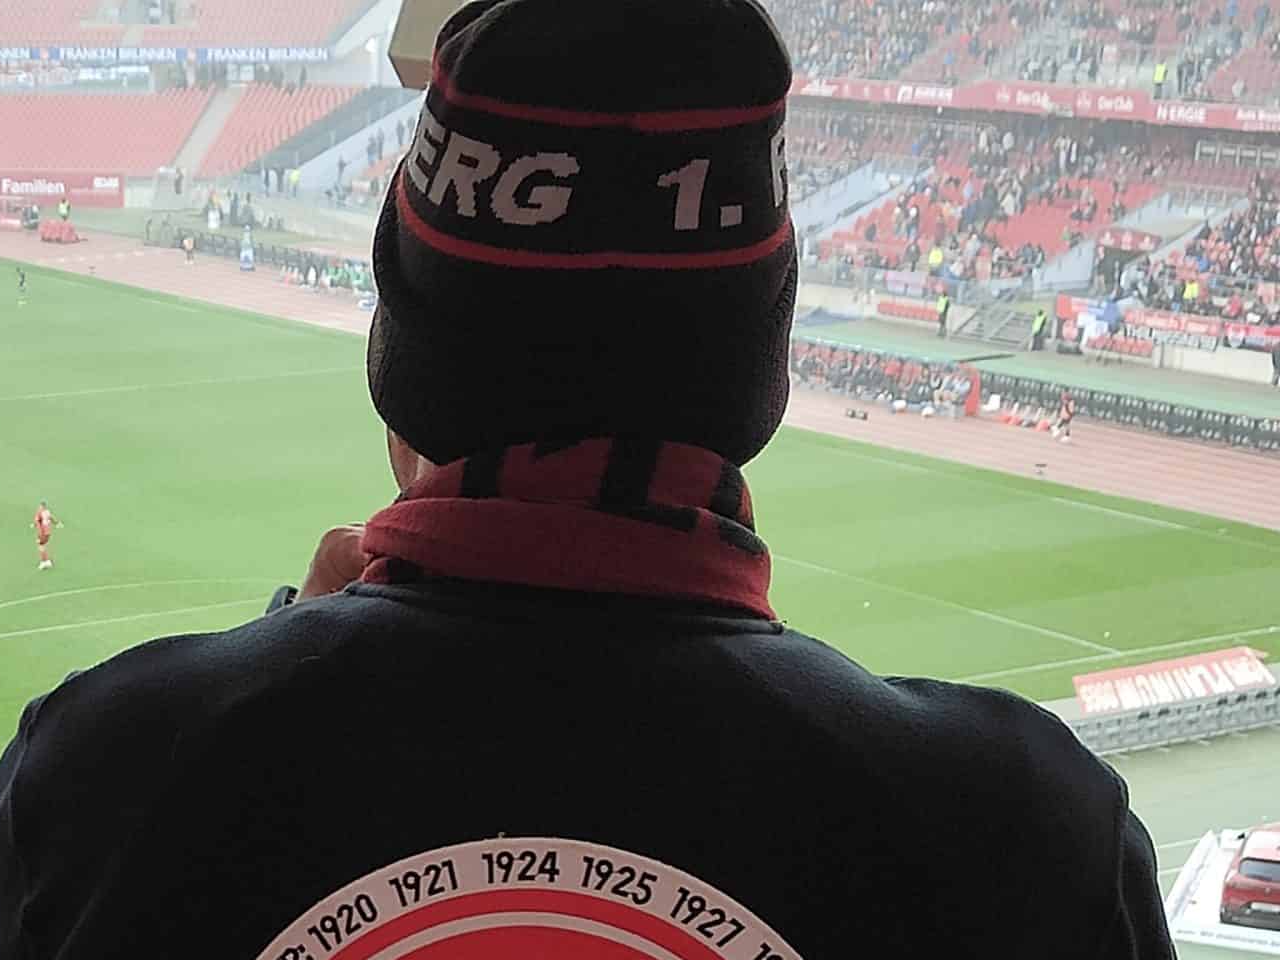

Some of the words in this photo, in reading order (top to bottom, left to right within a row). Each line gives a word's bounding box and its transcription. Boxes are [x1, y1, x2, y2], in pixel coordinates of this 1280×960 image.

[2, 177, 65, 194] Familien
[656, 158, 743, 230] 1.
[308, 893, 378, 952] 1920
[388, 859, 459, 907] 1921
[481, 850, 560, 884] 1924
[581, 855, 658, 905] 1925
[669, 886, 746, 948] 1927
